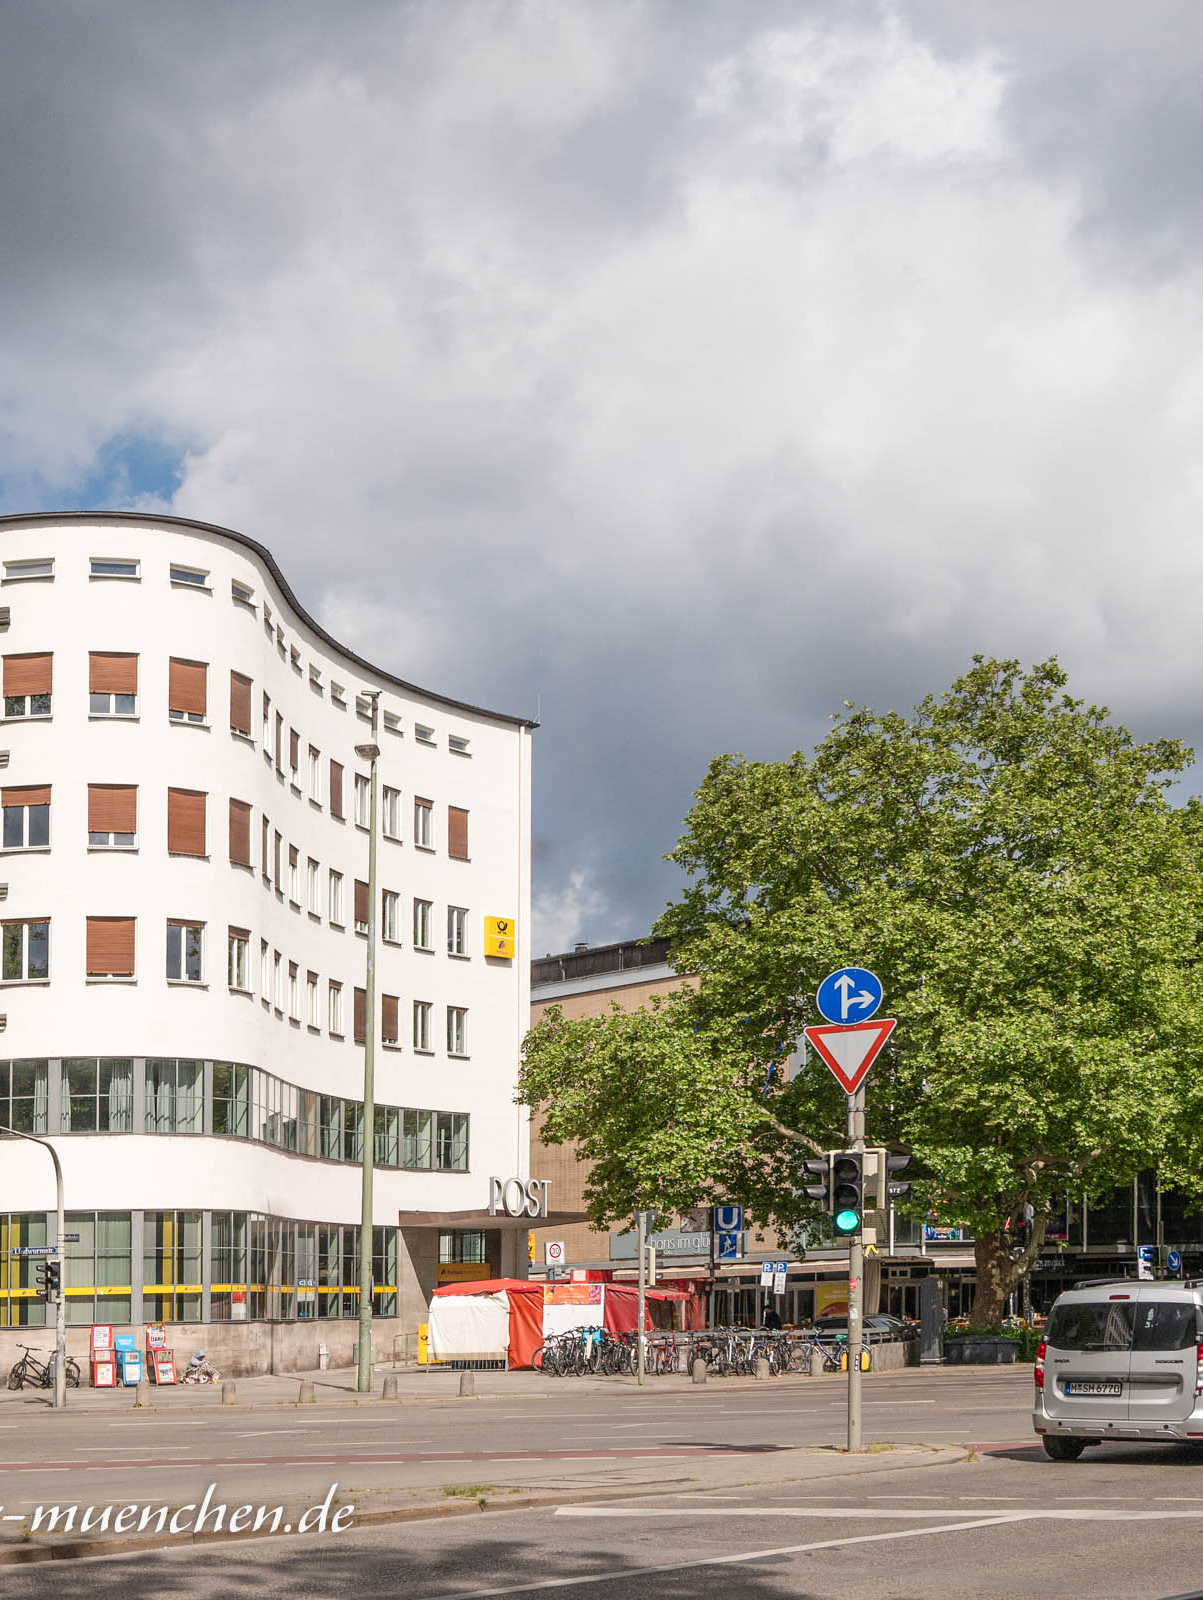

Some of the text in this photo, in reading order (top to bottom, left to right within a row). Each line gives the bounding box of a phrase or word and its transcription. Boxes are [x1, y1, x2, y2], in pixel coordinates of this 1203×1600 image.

[489, 1176, 553, 1218] POST
[717, 1207, 738, 1229] U
[692, 1232, 710, 1255] glü
